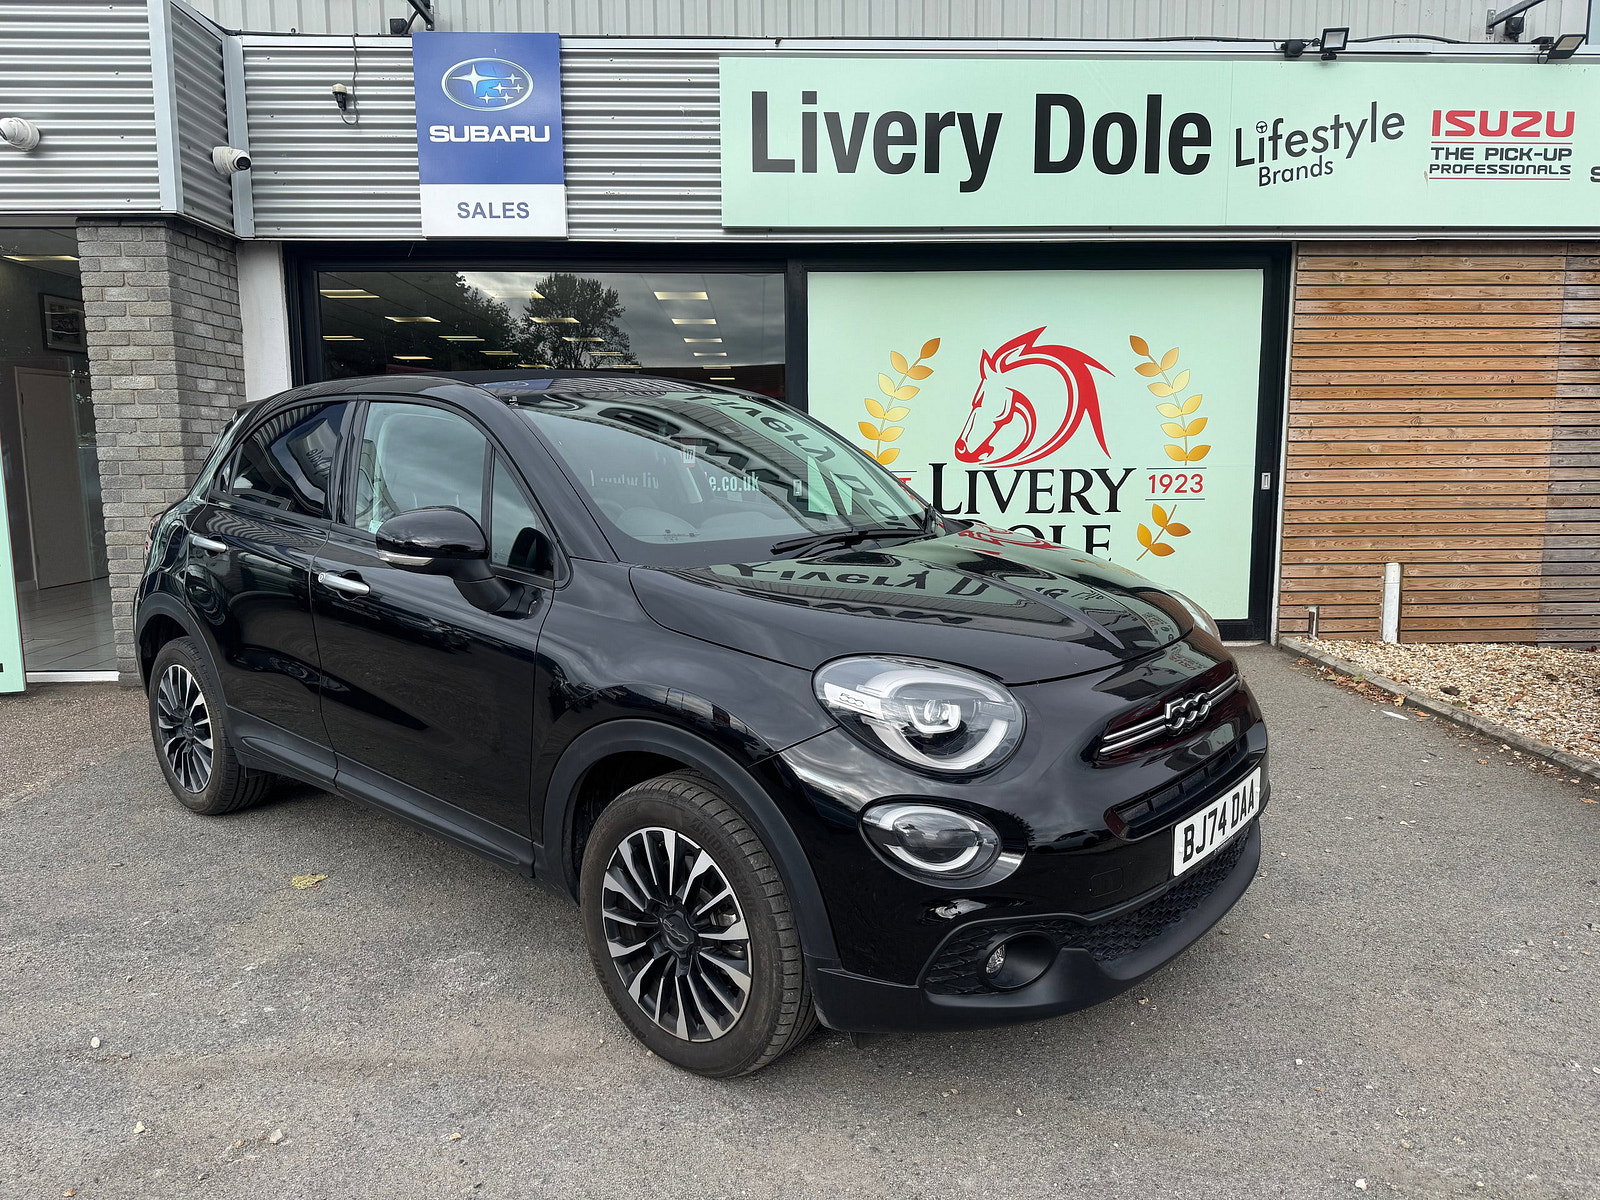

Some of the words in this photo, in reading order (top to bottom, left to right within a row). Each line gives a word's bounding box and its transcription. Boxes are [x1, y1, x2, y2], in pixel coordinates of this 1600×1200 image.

[429, 125, 551, 143] SUBARU
[1235, 101, 1405, 168] Lifestyle
[1431, 109, 1575, 138] ISUZU
[751, 90, 1003, 193] Livery
[1033, 92, 1213, 176] Dole
[1430, 147, 1474, 161] THE
[1484, 147, 1573, 162] PICK-UP
[1258, 155, 1334, 187] Brands
[1429, 164, 1571, 176] PROFESSIONALS
[457, 202, 530, 219] SALES
[928, 463, 1136, 516] LIVERY
[1148, 474, 1204, 494] 1923
[1183, 802, 1227, 864] BJ74
[1231, 779, 1255, 830] DAA
